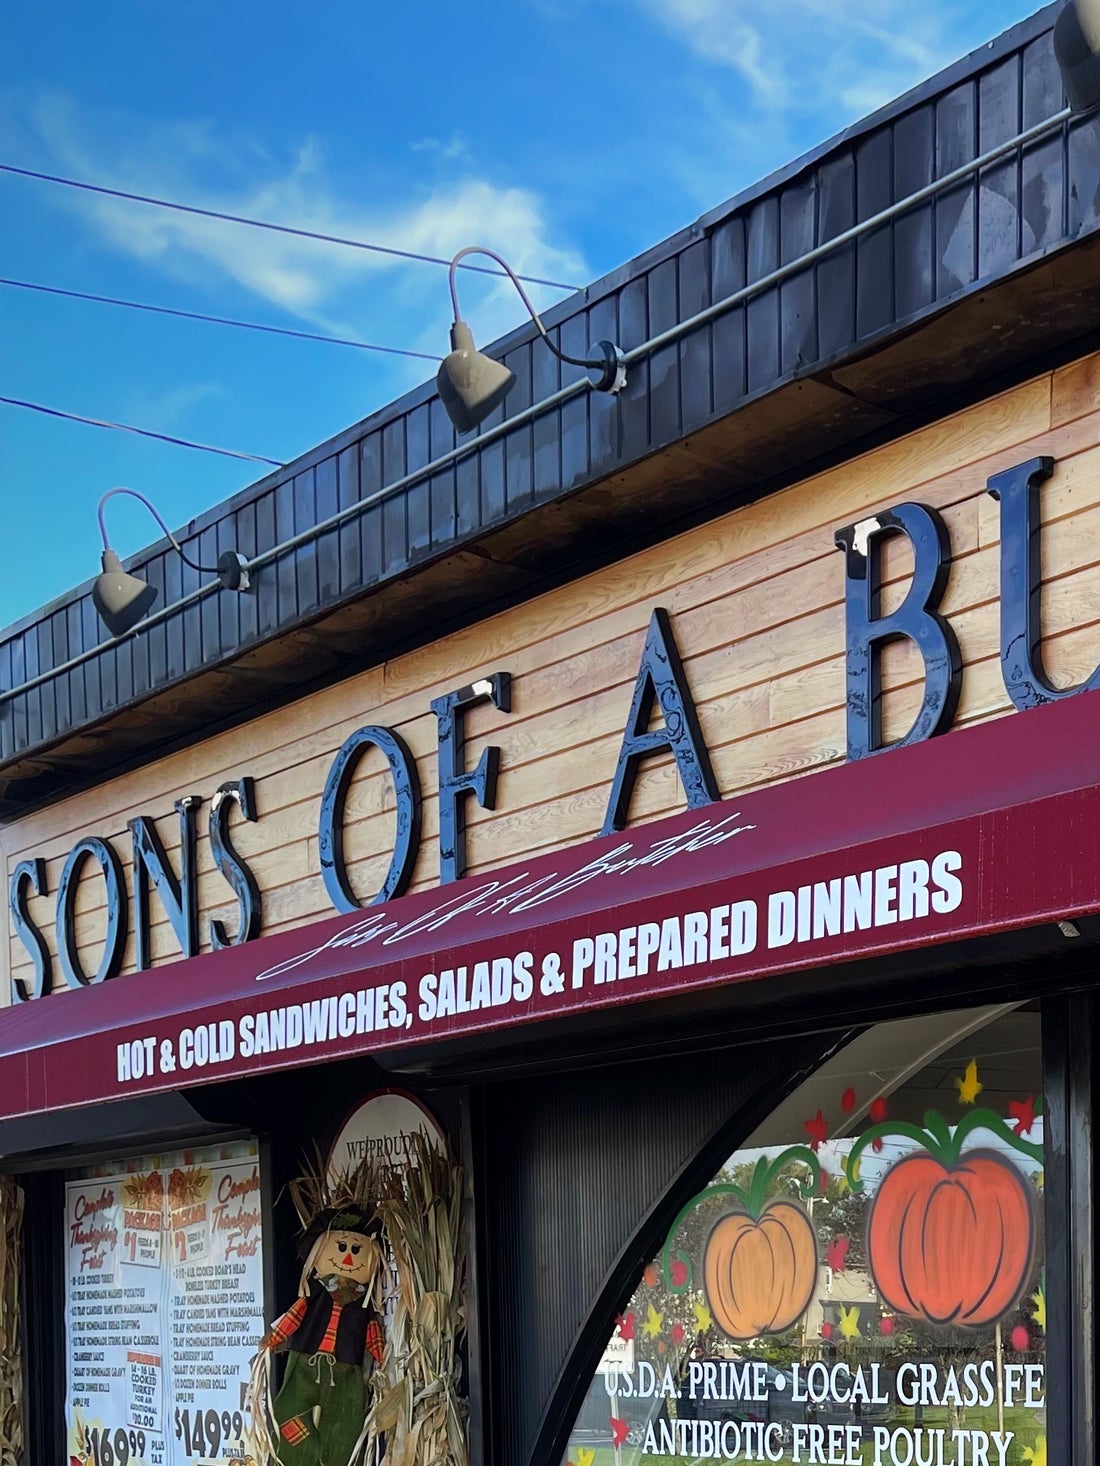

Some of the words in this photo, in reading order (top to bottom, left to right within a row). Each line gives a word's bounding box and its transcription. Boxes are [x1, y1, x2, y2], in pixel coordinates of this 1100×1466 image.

[10, 776, 260, 1002] SONS
[319, 675, 511, 914] OF
[598, 607, 721, 838] A
[116, 1036, 156, 1082] HOT
[159, 1038, 176, 1073] &
[179, 1019, 235, 1069] COLD
[239, 980, 413, 1058] SANDWICHES,
[418, 951, 534, 1021] SALADS
[540, 952, 566, 997] &
[572, 900, 757, 989] PREPARED
[767, 851, 963, 949] DINNERS
[346, 1140, 366, 1160] WE
[368, 1132, 424, 1158] PROUDL
[131, 1373, 156, 1386] COOKED
[132, 1384, 155, 1396] TURKEY
[688, 1361, 769, 1402] PRIME
[791, 1361, 888, 1405] LOCAL
[896, 1360, 995, 1408] GRASS
[1004, 1364, 1046, 1408] FE
[151, 1440, 165, 1451] PLUS
[642, 1418, 786, 1462] ANTIBIOTIC
[791, 1424, 863, 1466] FREE
[151, 1454, 162, 1464] TAX
